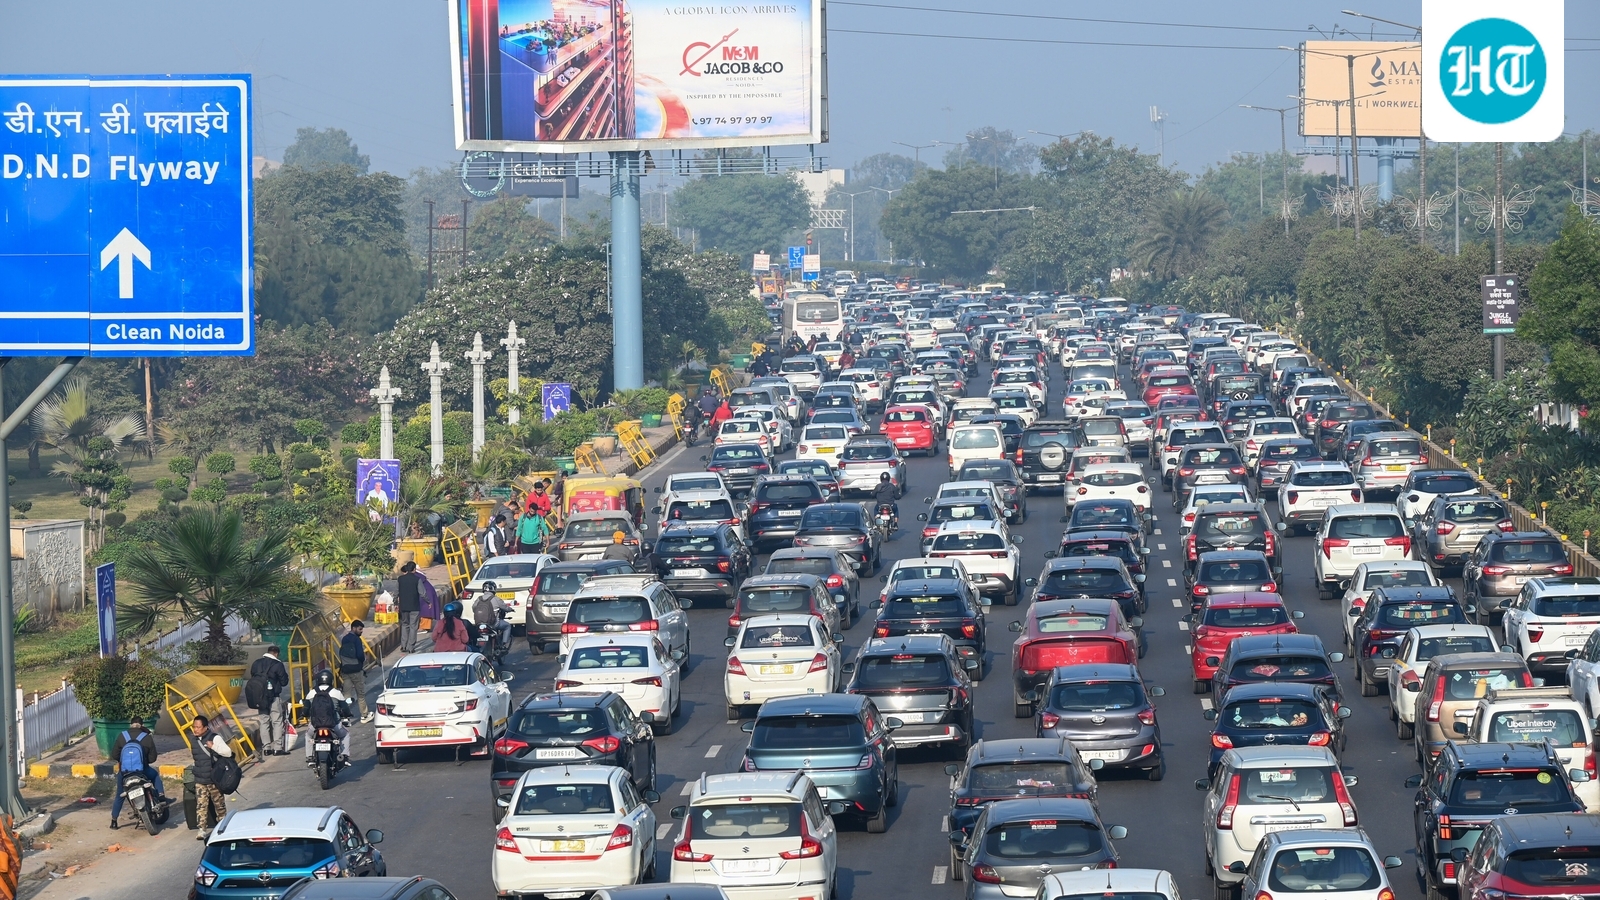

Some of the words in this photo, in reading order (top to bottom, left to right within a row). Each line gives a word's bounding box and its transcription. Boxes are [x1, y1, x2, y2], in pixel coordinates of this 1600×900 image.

[663, 7, 671, 15] A
[673, 6, 717, 15] GLOBAL
[720, 5, 748, 14] ICON
[751, 4, 797, 14] ARRIVES
[722, 45, 759, 61] M3M
[1389, 60, 1421, 76] MA
[1371, 100, 1420, 108] WORKWEL
[99, 102, 136, 135] डी.
[143, 102, 230, 138] फ्लाईवे
[699, 117, 712, 125] 97
[715, 117, 727, 125] 74
[730, 116, 742, 124] 97
[745, 116, 757, 124] 97
[760, 116, 773, 124] 97
[3, 153, 90, 179] D.N.D
[109, 155, 220, 187] Flyway
[106, 323, 162, 340] Clean
[169, 323, 226, 340] Noida
[1506, 719, 1527, 728] Uber
[1527, 719, 1556, 728] Intercity
